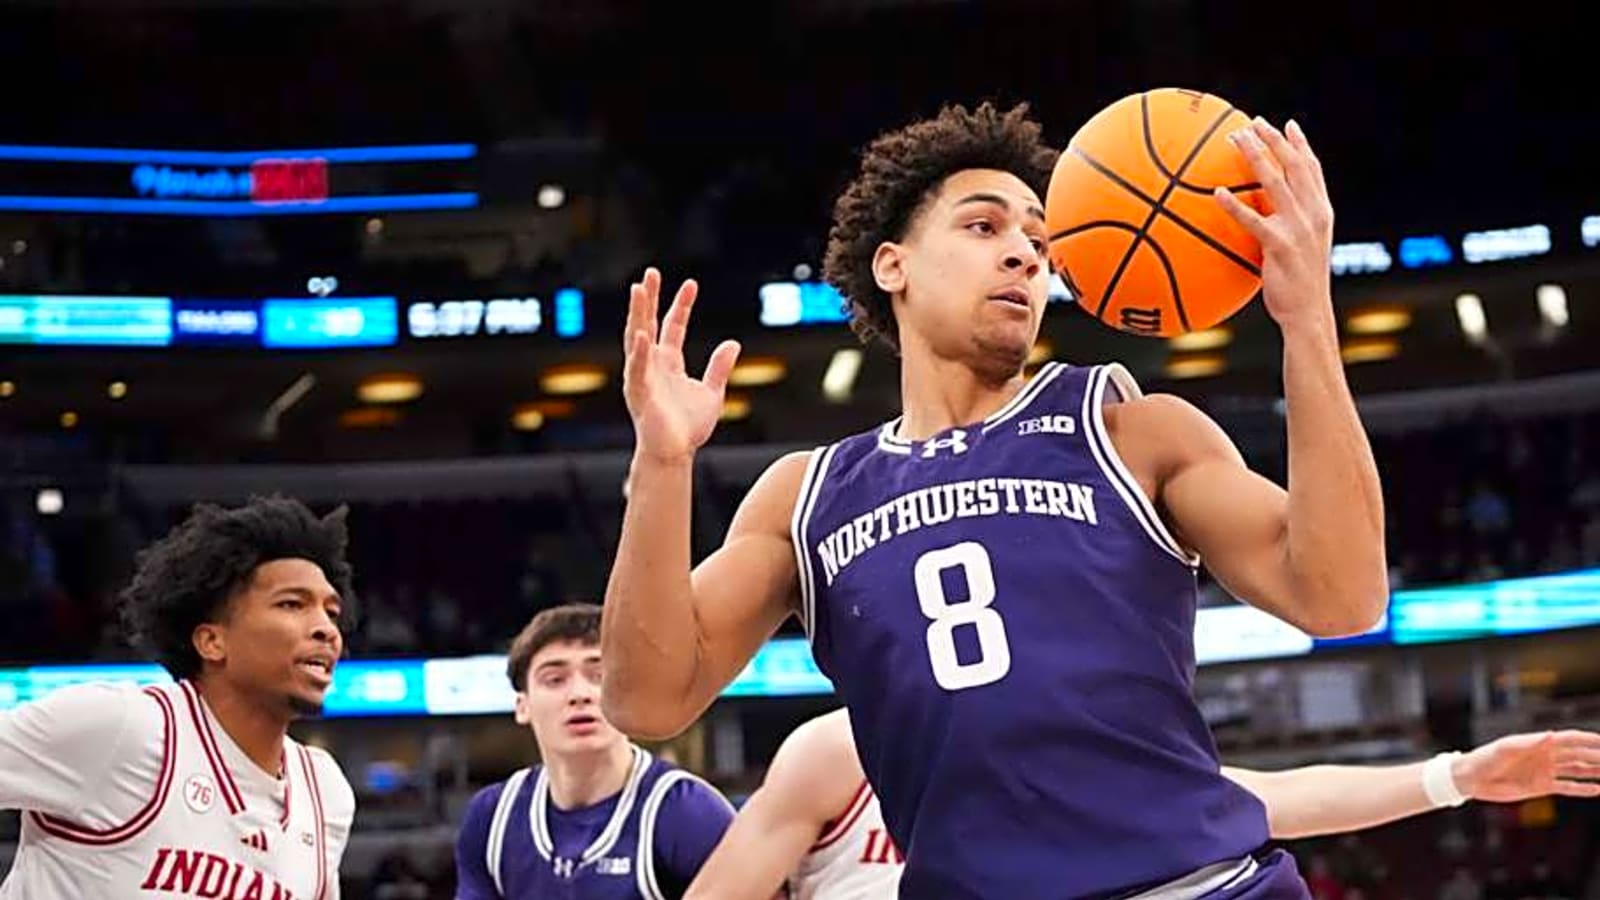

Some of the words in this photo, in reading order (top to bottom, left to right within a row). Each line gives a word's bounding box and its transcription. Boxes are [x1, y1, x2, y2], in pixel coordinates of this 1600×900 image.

[817, 478, 1098, 586] NORTHWESTERN
[914, 541, 1011, 691] 8
[191, 781, 211, 805] 76
